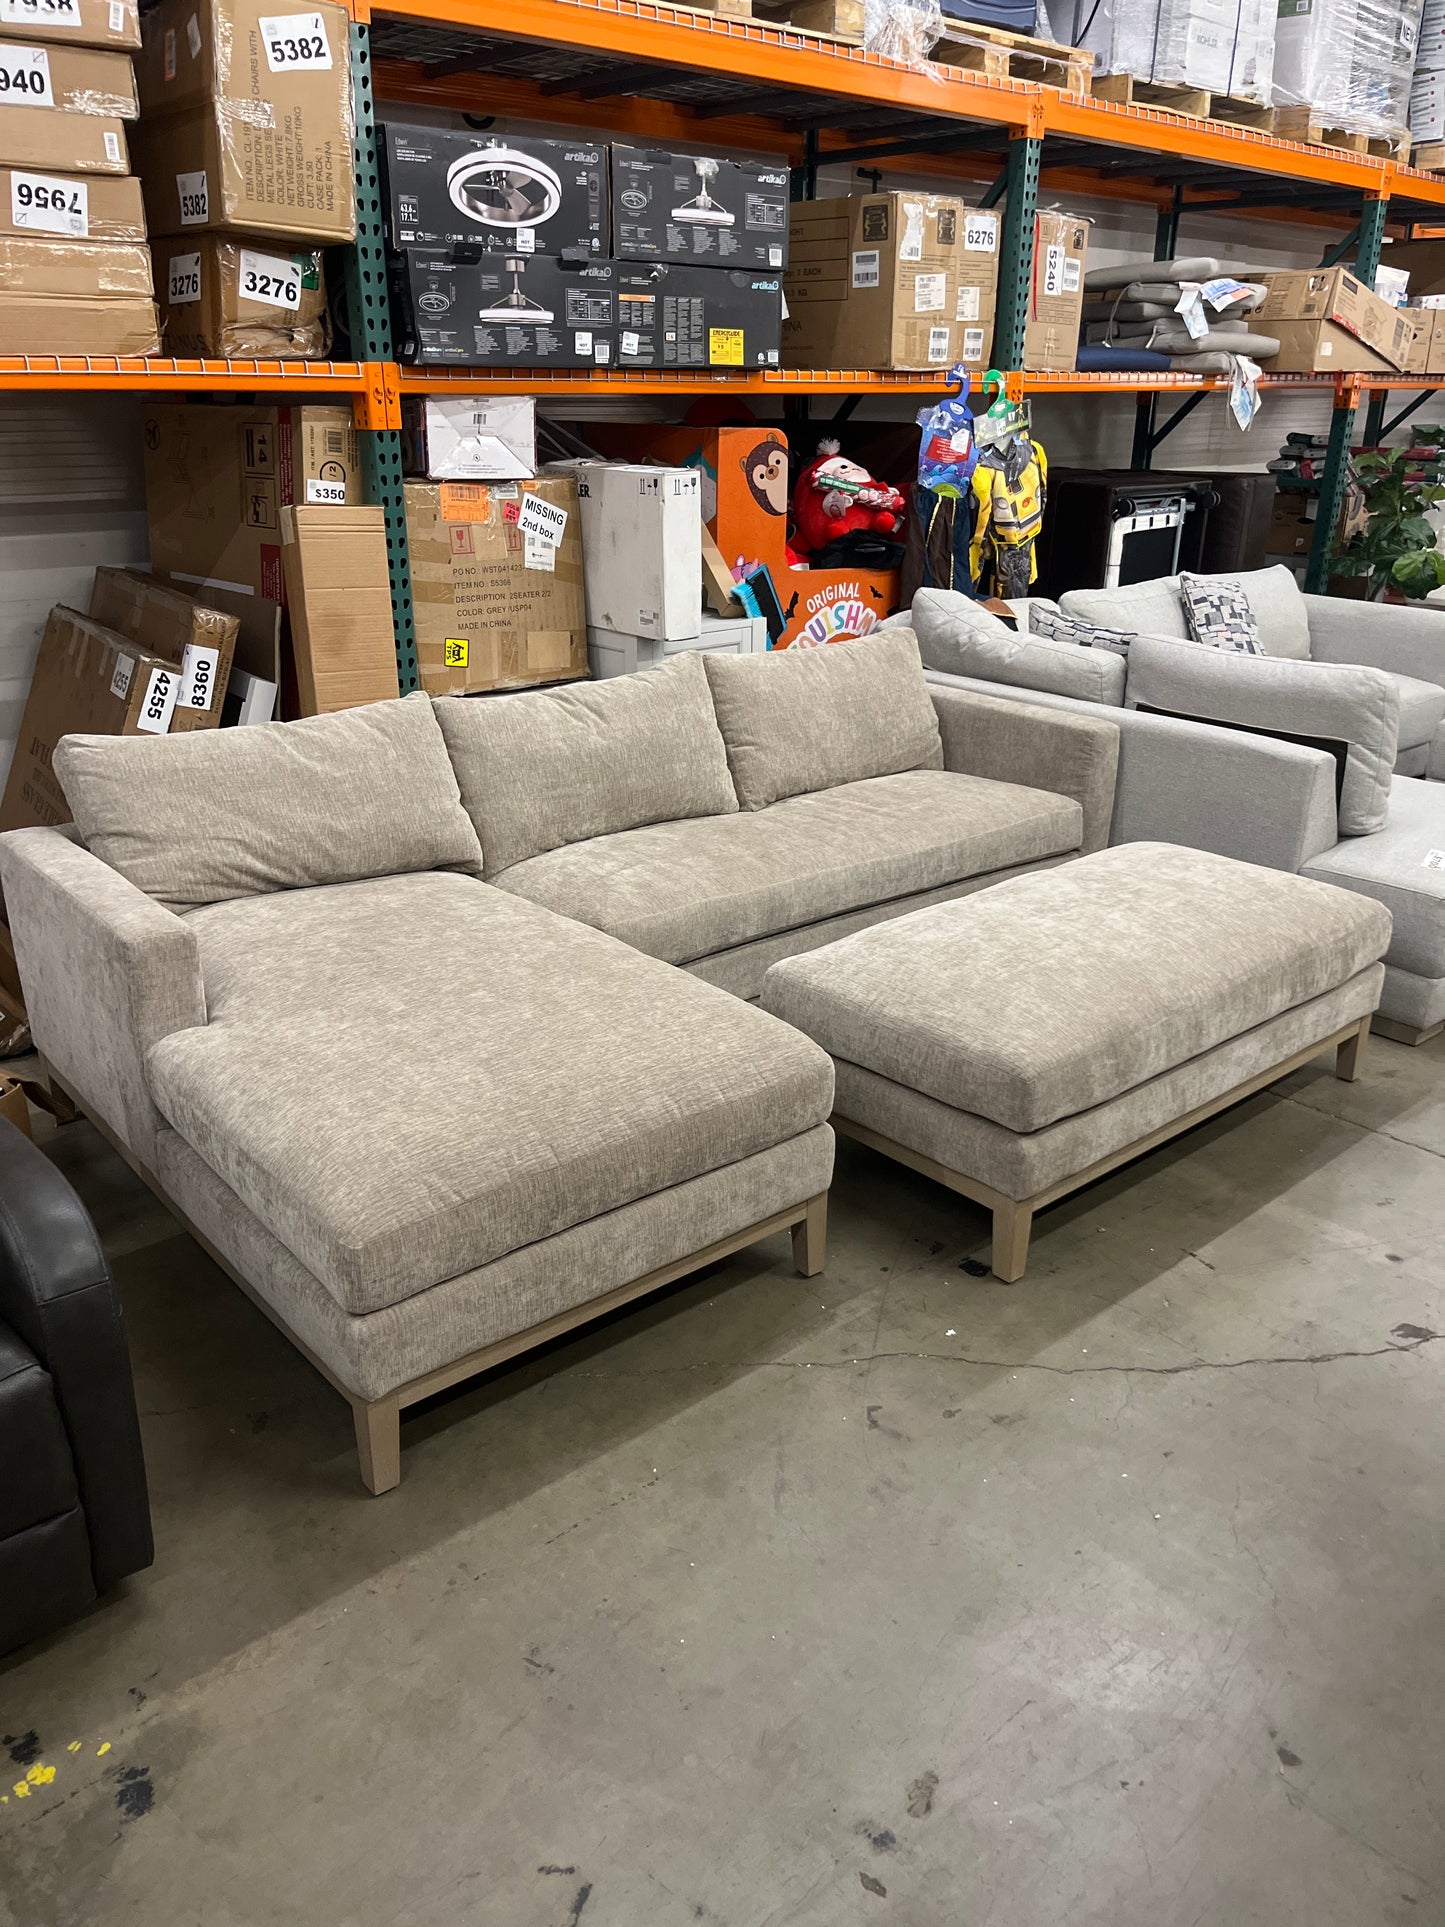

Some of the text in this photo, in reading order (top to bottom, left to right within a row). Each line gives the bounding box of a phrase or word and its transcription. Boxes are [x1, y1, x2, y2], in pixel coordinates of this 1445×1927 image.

[249, 30, 257, 55] WITH
[271, 36, 326, 63] 5382
[251, 59, 260, 94] CHAIRS
[564, 152, 591, 163] artika
[267, 172, 275, 203] METAL
[324, 141, 334, 211] MADE IN CHINA
[757, 174, 780, 183] artika
[17, 183, 82, 215] 7956
[245, 177, 254, 201] ITEM
[287, 189, 295, 206] NET
[296, 173, 305, 207] GROSS
[316, 184, 324, 210] CASE
[183, 193, 207, 217] 5382
[967, 229, 994, 246] 6276
[1046, 249, 1058, 292] 5240
[171, 273, 198, 297] 3276
[244, 271, 297, 302] 3276
[752, 281, 774, 290] artika
[315, 487, 345, 500] $350
[578, 484, 590, 498] ER
[525, 498, 564, 526] MISSING
[522, 516, 554, 540] 2nd box
[510, 591, 540, 599] 2SEATER
[806, 582, 861, 613] ORIGINAL
[487, 606, 506, 614] GREY
[458, 619, 512, 631] MADE IN CHINA
[789, 605, 874, 650] QUISHM
[112, 670, 129, 693] 4255
[191, 660, 211, 707] 8360
[147, 672, 171, 720] 4255
